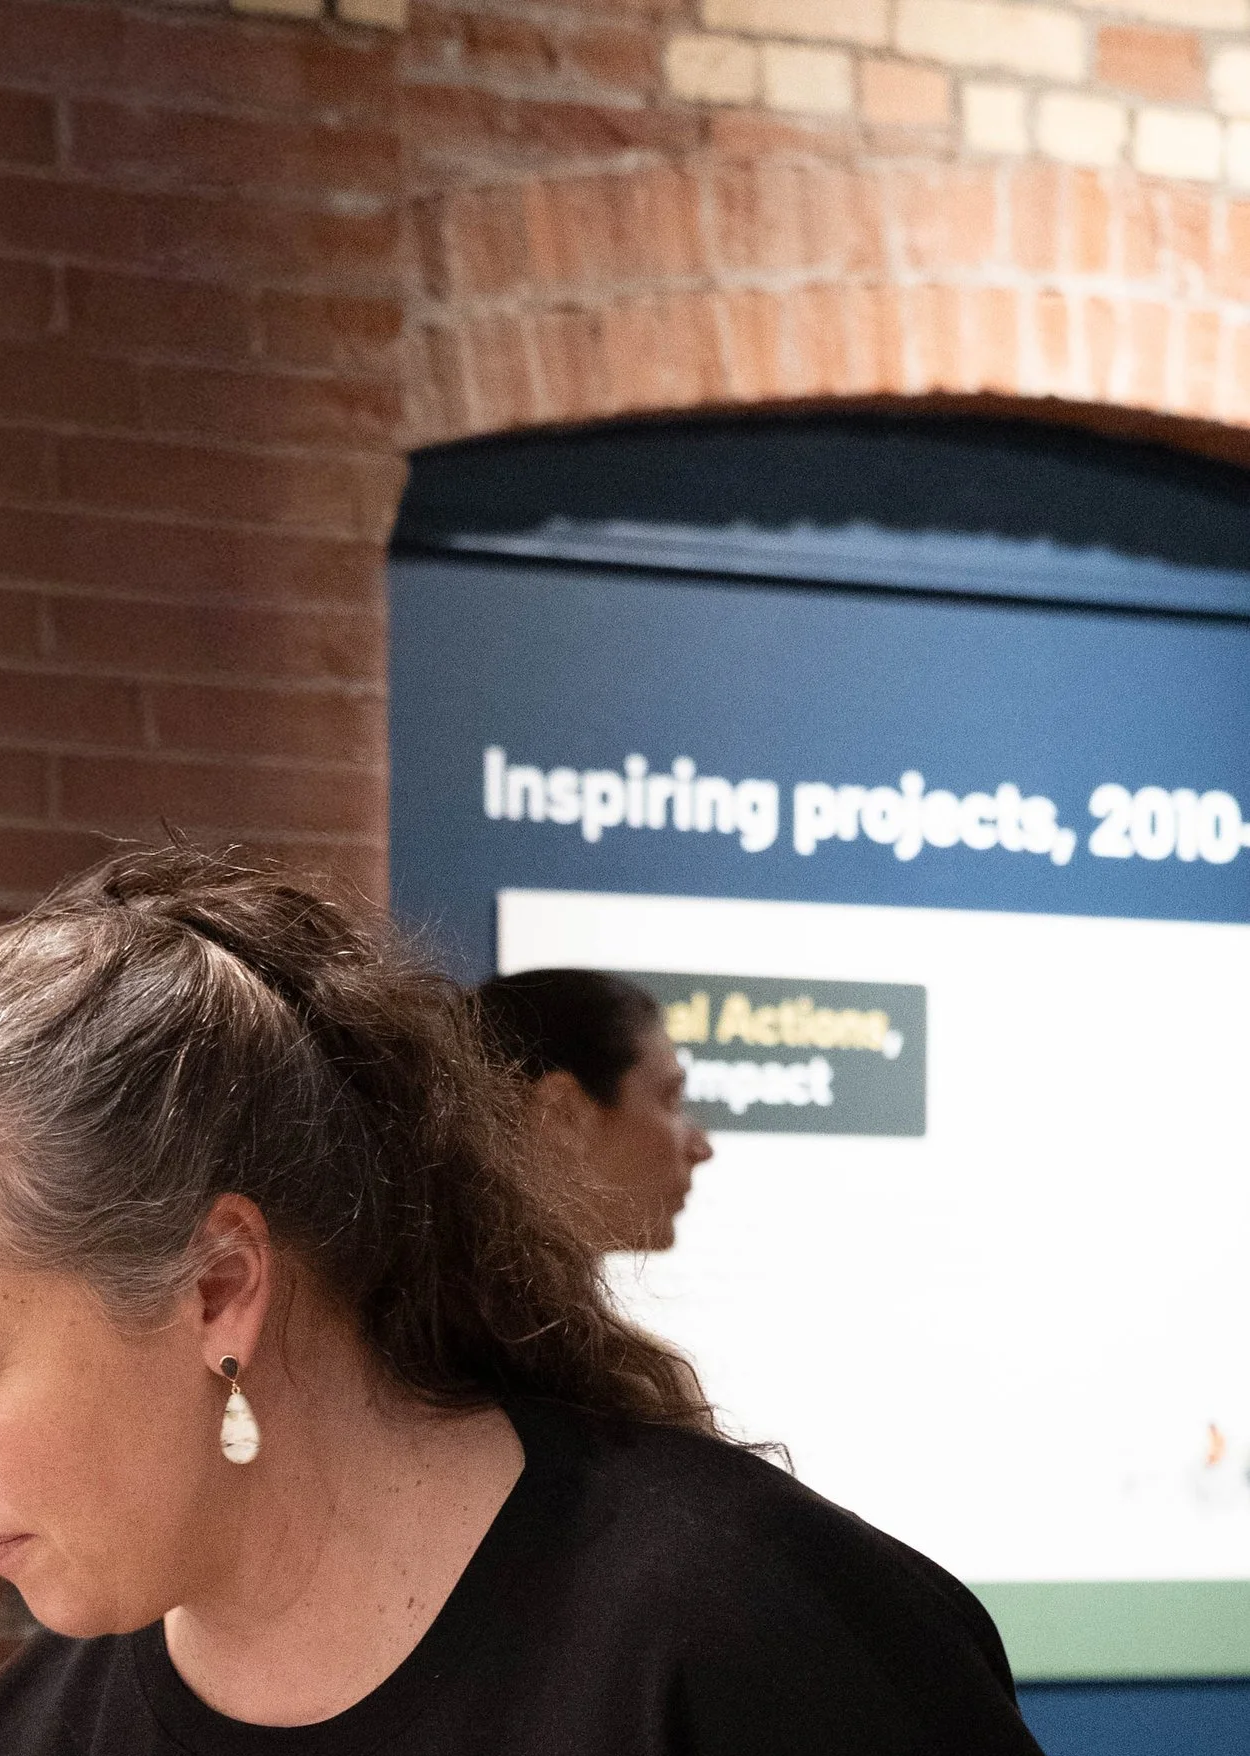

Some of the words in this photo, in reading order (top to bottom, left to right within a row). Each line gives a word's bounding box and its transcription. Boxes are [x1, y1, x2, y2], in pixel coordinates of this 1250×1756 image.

[483, 746, 779, 853] Inspiring
[793, 770, 1077, 866] projects,
[716, 992, 904, 1060] Actions,
